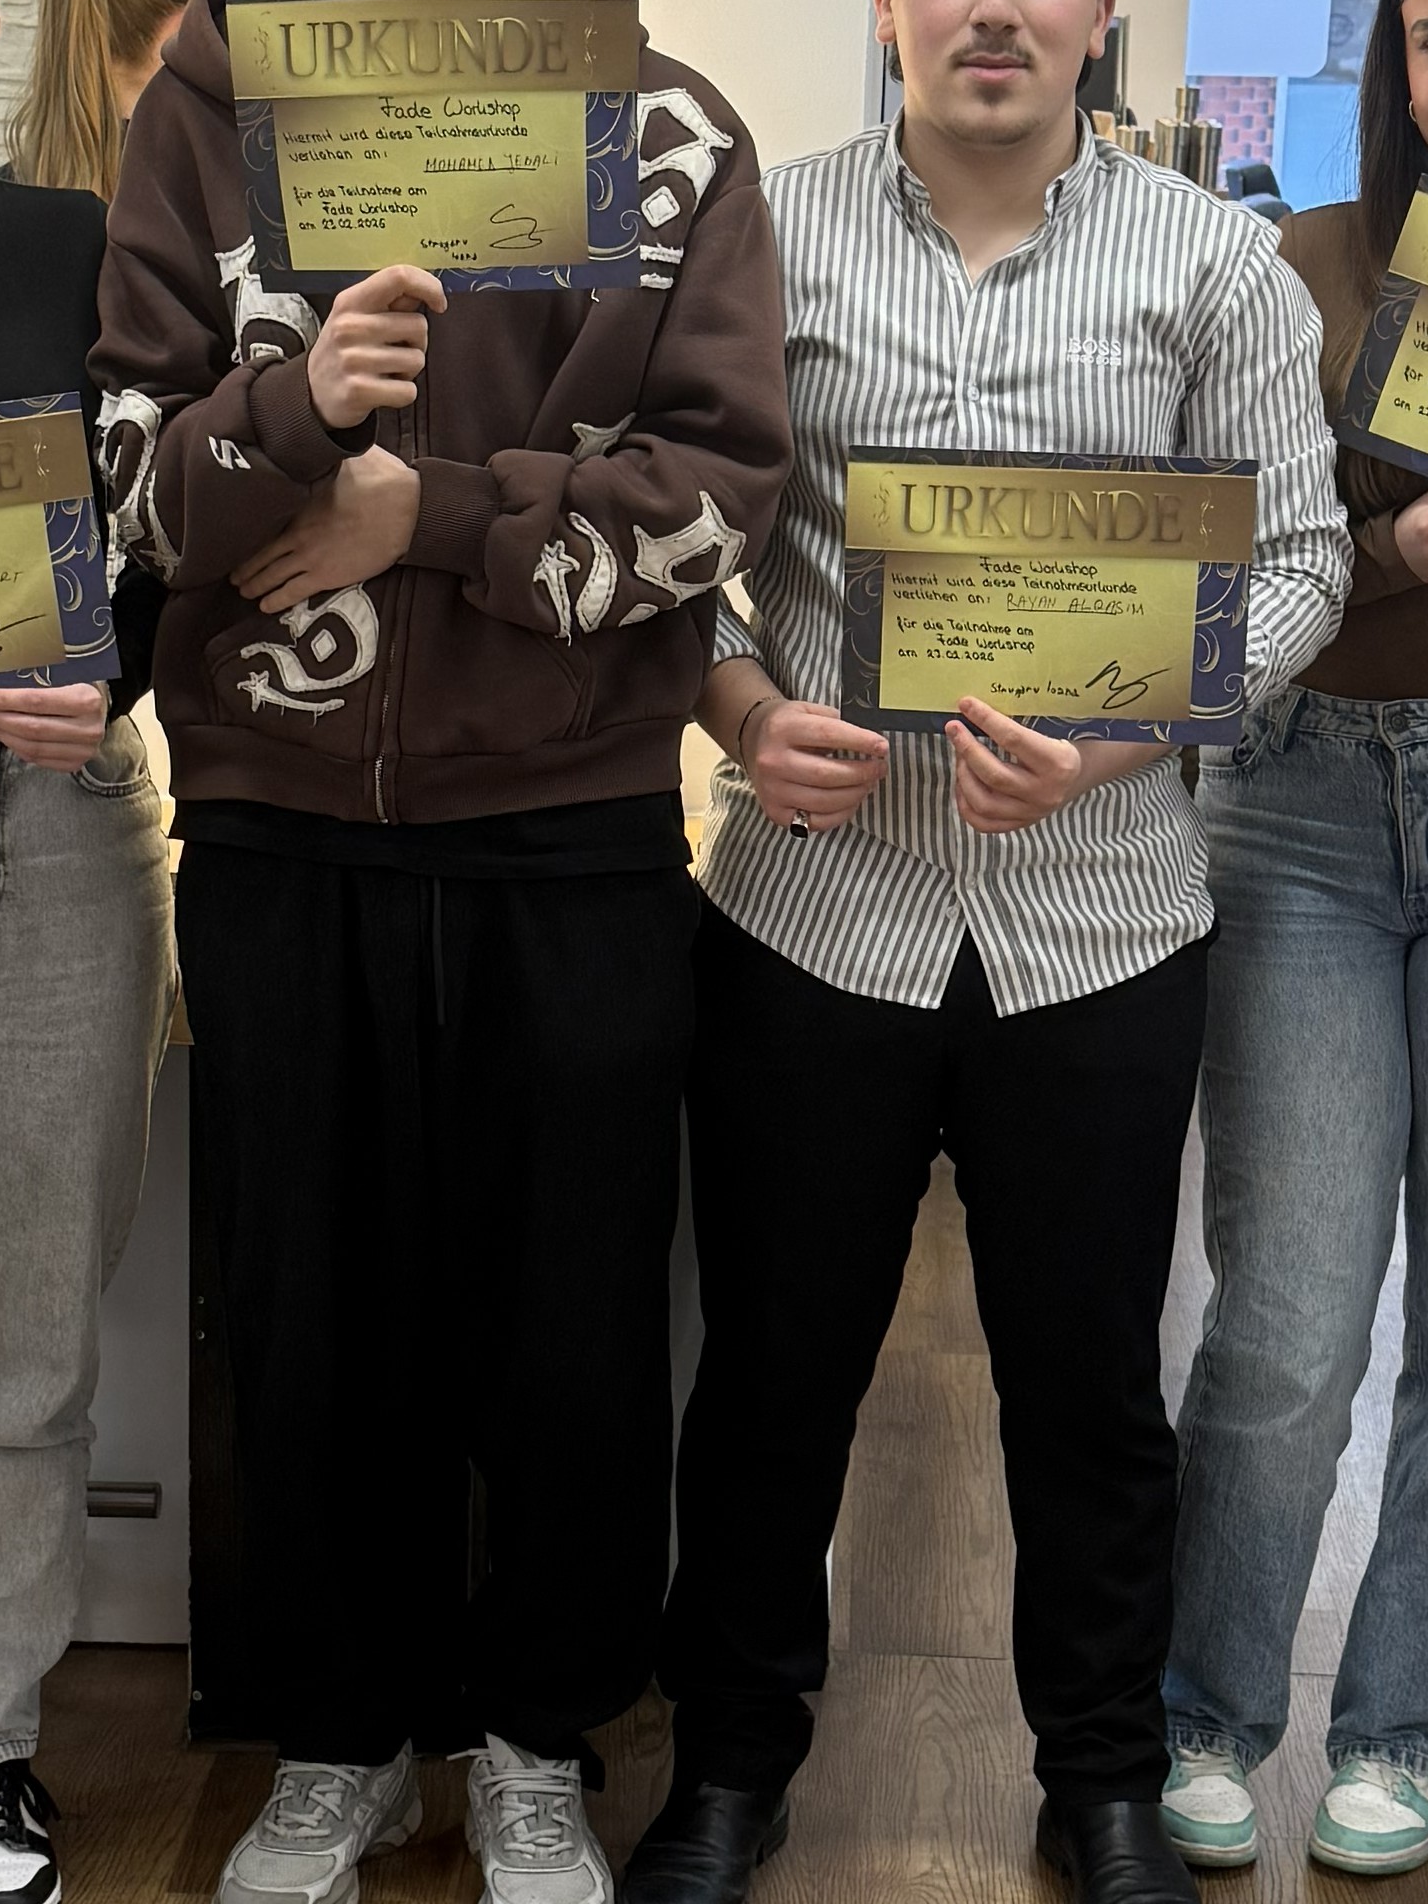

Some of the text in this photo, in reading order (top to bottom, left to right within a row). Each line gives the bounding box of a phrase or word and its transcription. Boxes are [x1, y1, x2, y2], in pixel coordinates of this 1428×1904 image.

[279, 17, 568, 78] URKUNDE
[379, 97, 521, 121] Fade Workshop
[408, 186, 427, 196] am
[299, 221, 316, 230] am
[1394, 397, 1411, 411] am
[901, 483, 1183, 543] URKUNDE
[979, 556, 1098, 579] Fade Workshop
[1016, 626, 1034, 636] am
[898, 649, 918, 658] am
